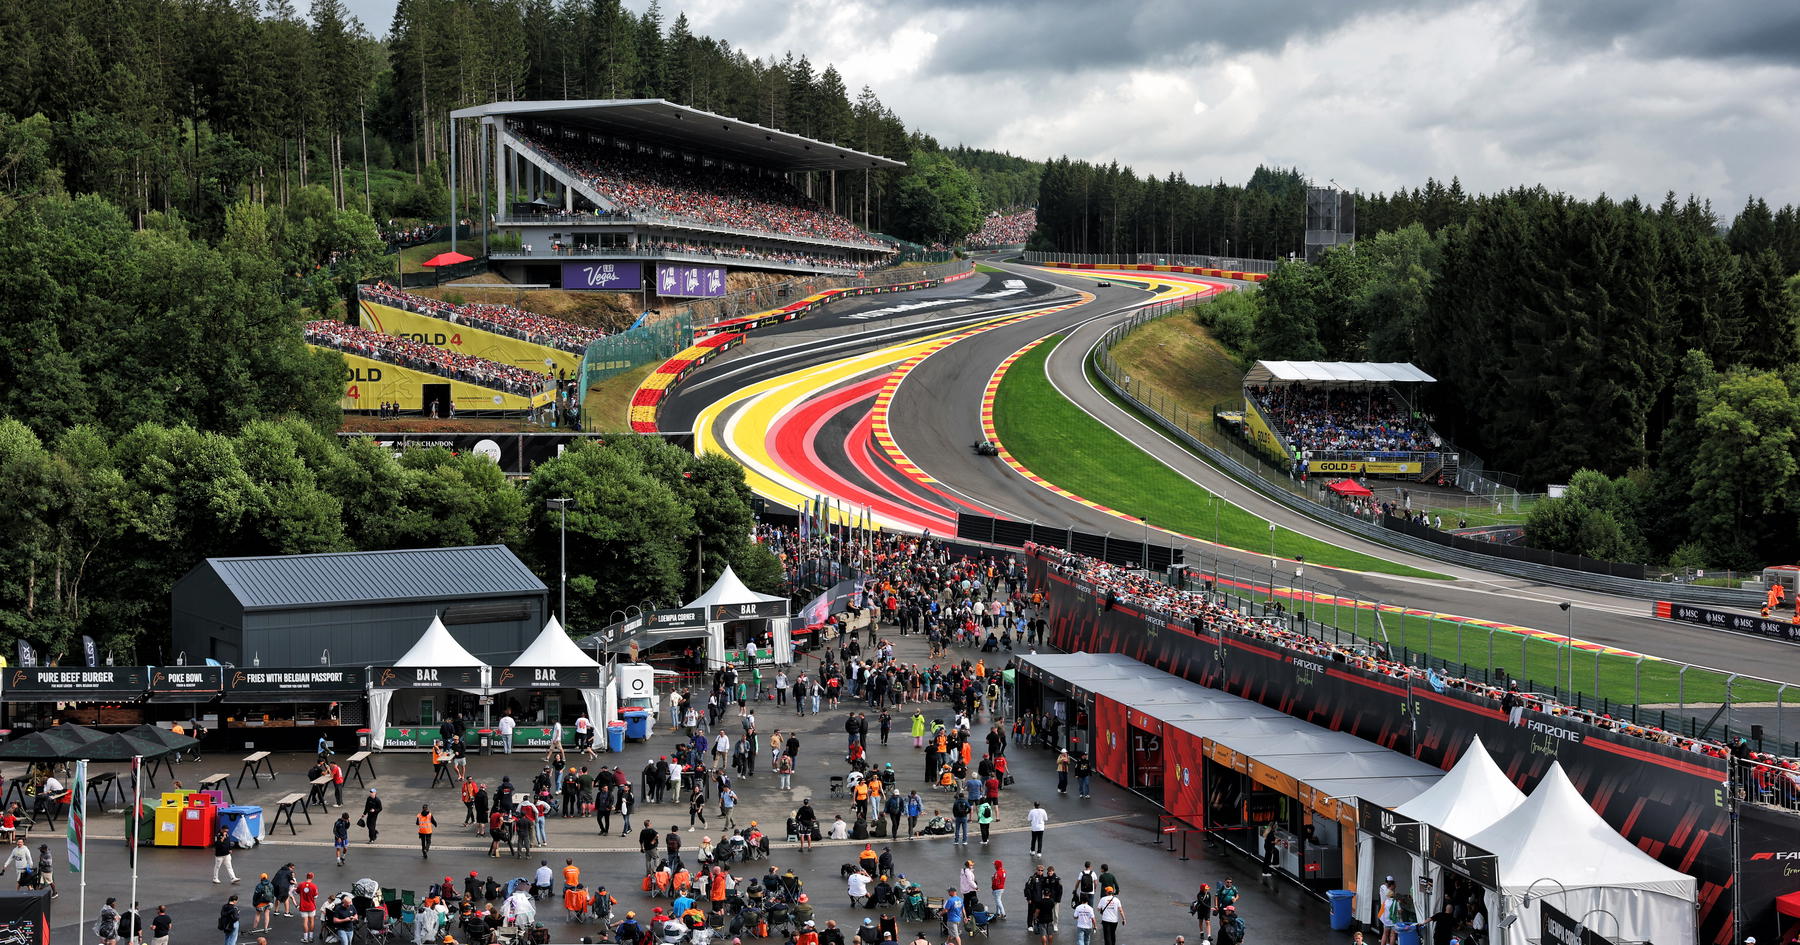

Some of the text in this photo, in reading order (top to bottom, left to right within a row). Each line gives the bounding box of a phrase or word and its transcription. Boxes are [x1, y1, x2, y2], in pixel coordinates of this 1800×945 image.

[583, 265, 620, 287] Vegas
[450, 333, 463, 346] 4
[346, 385, 360, 400] 4
[1320, 462, 1357, 471] GOLD 5
[740, 604, 757, 614] BAR
[1685, 608, 1699, 618] MSC
[677, 612, 696, 621] CORNER
[1711, 613, 1726, 623] MSC
[1739, 618, 1754, 628] MSC
[1766, 623, 1780, 633] MSC
[1293, 657, 1324, 674] FANZONE
[37, 672, 114, 683] PURE BEEF BURGER
[168, 673, 204, 683] POKE BOWL
[247, 672, 343, 683] FRIES WITH BELGIAN PASSPORT
[416, 668, 439, 681] BAR
[534, 668, 557, 681] BAR
[1401, 702, 1407, 716] F
[1415, 702, 1421, 715] E
[1527, 719, 1580, 743] FANZONE
[528, 738, 553, 746] Heine
[1714, 788, 1724, 807] E
